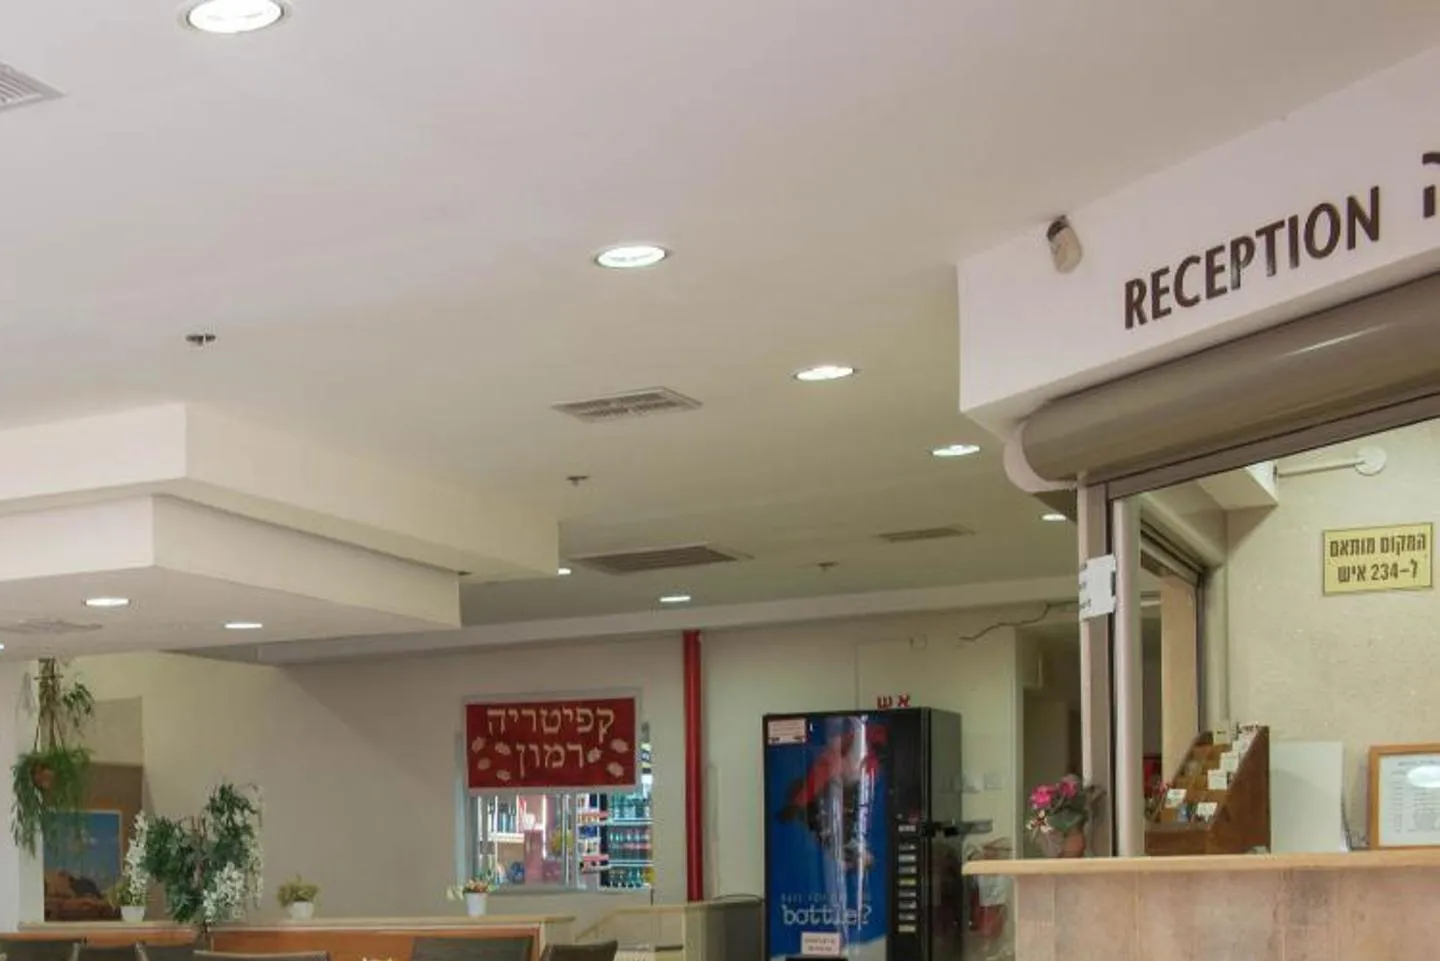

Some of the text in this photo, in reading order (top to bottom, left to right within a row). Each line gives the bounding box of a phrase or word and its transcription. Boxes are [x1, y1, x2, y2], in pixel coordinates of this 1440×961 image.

[1124, 185, 1380, 330] RECEPTION
[1329, 533, 1426, 557] המקום מותאם
[1337, 564, 1367, 583] איש
[486, 706, 616, 743] קפיטריה
[515, 741, 585, 778] רמון
[781, 903, 873, 926] bottle?
